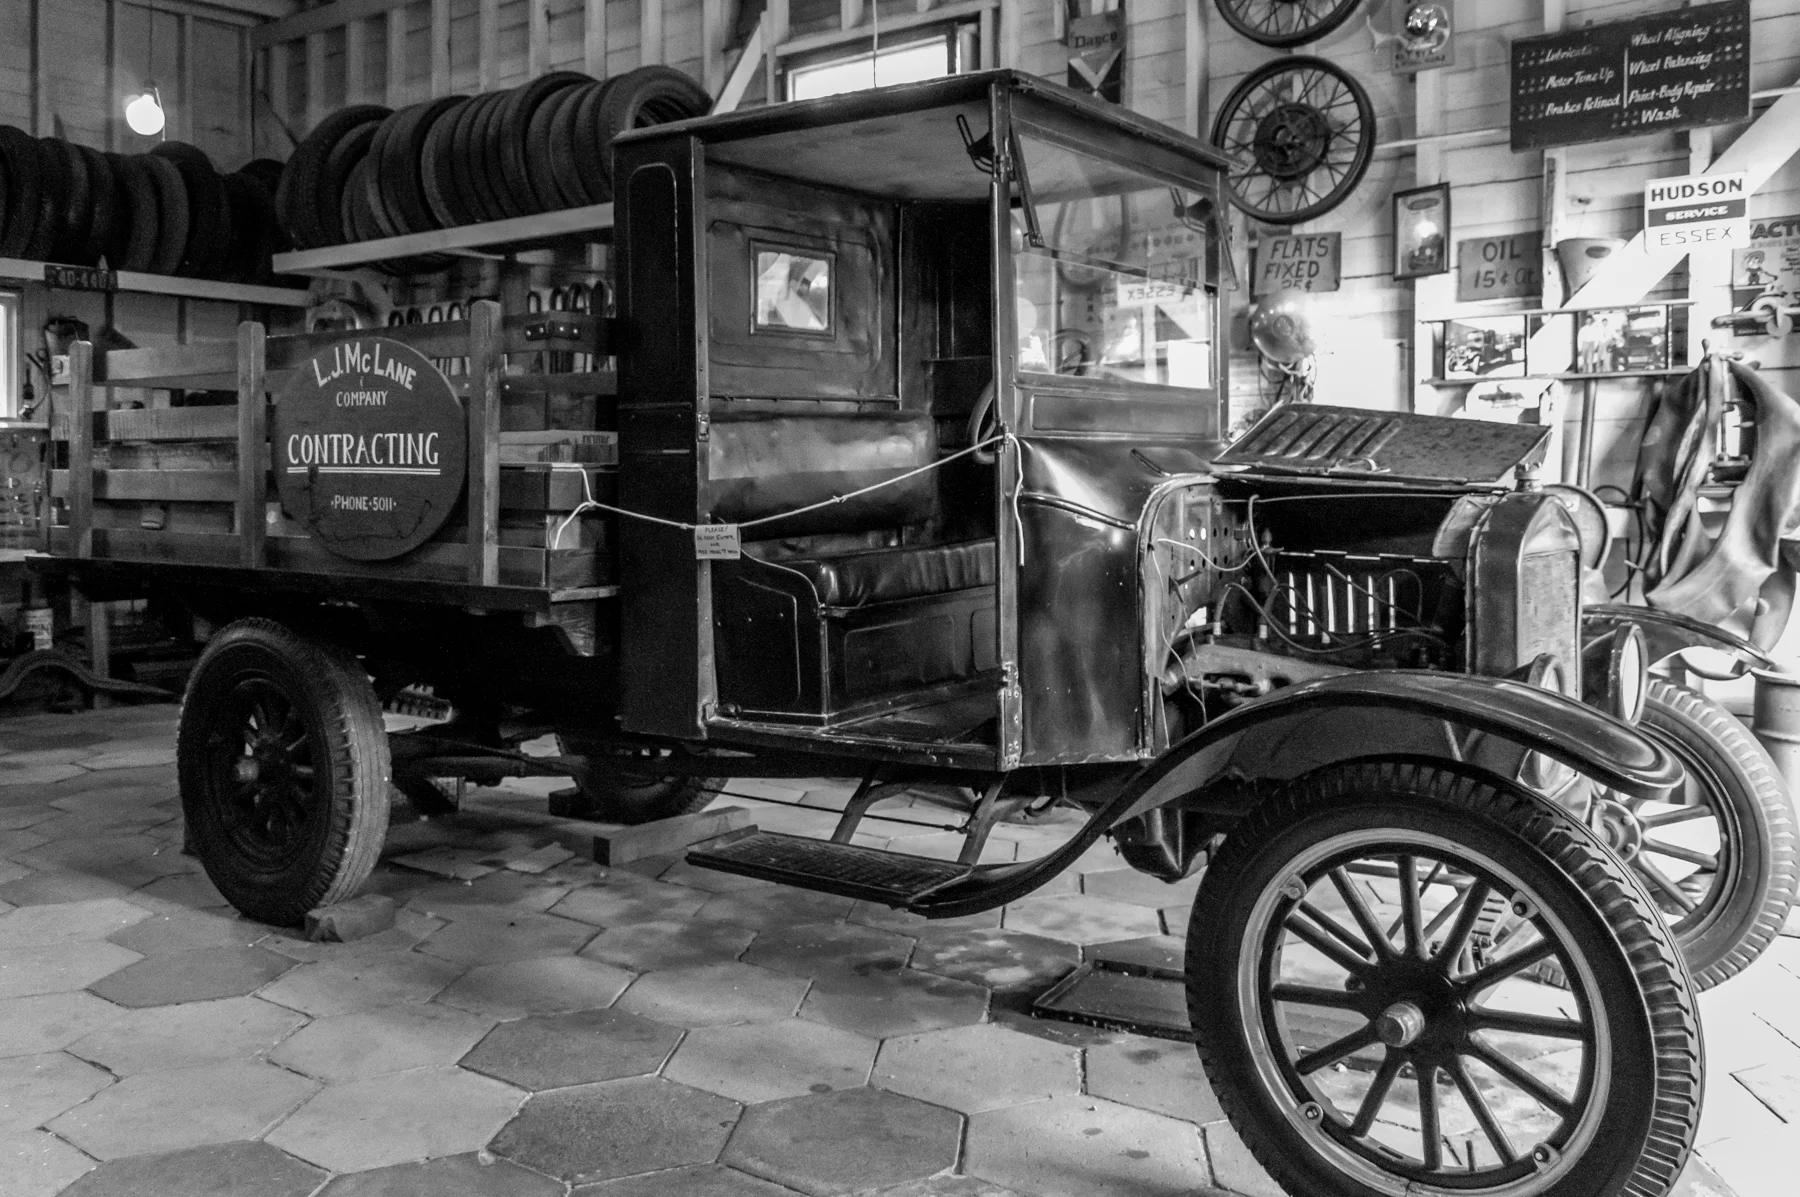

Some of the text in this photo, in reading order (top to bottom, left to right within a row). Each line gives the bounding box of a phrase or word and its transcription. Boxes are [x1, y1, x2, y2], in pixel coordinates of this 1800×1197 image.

[1631, 24, 1712, 47] Wheel Aligning
[1629, 51, 1714, 76] Wheel Balancing
[1545, 67, 1615, 90] Motor Tune Up
[1683, 78, 1716, 100] Repair
[1545, 93, 1621, 117] Brakes Relined
[1641, 105, 1682, 124] Wash
[1651, 178, 1743, 202] HUDSON
[1665, 206, 1728, 221] SERVICE
[1660, 226, 1732, 246] ESSEX
[1750, 219, 1800, 240] ACT
[1269, 236, 1329, 260] FLATS
[1482, 238, 1522, 263] OIL
[1263, 259, 1320, 280] FIXED
[336, 391, 389, 407] COMPANY
[287, 432, 439, 465] CONTRACTING
